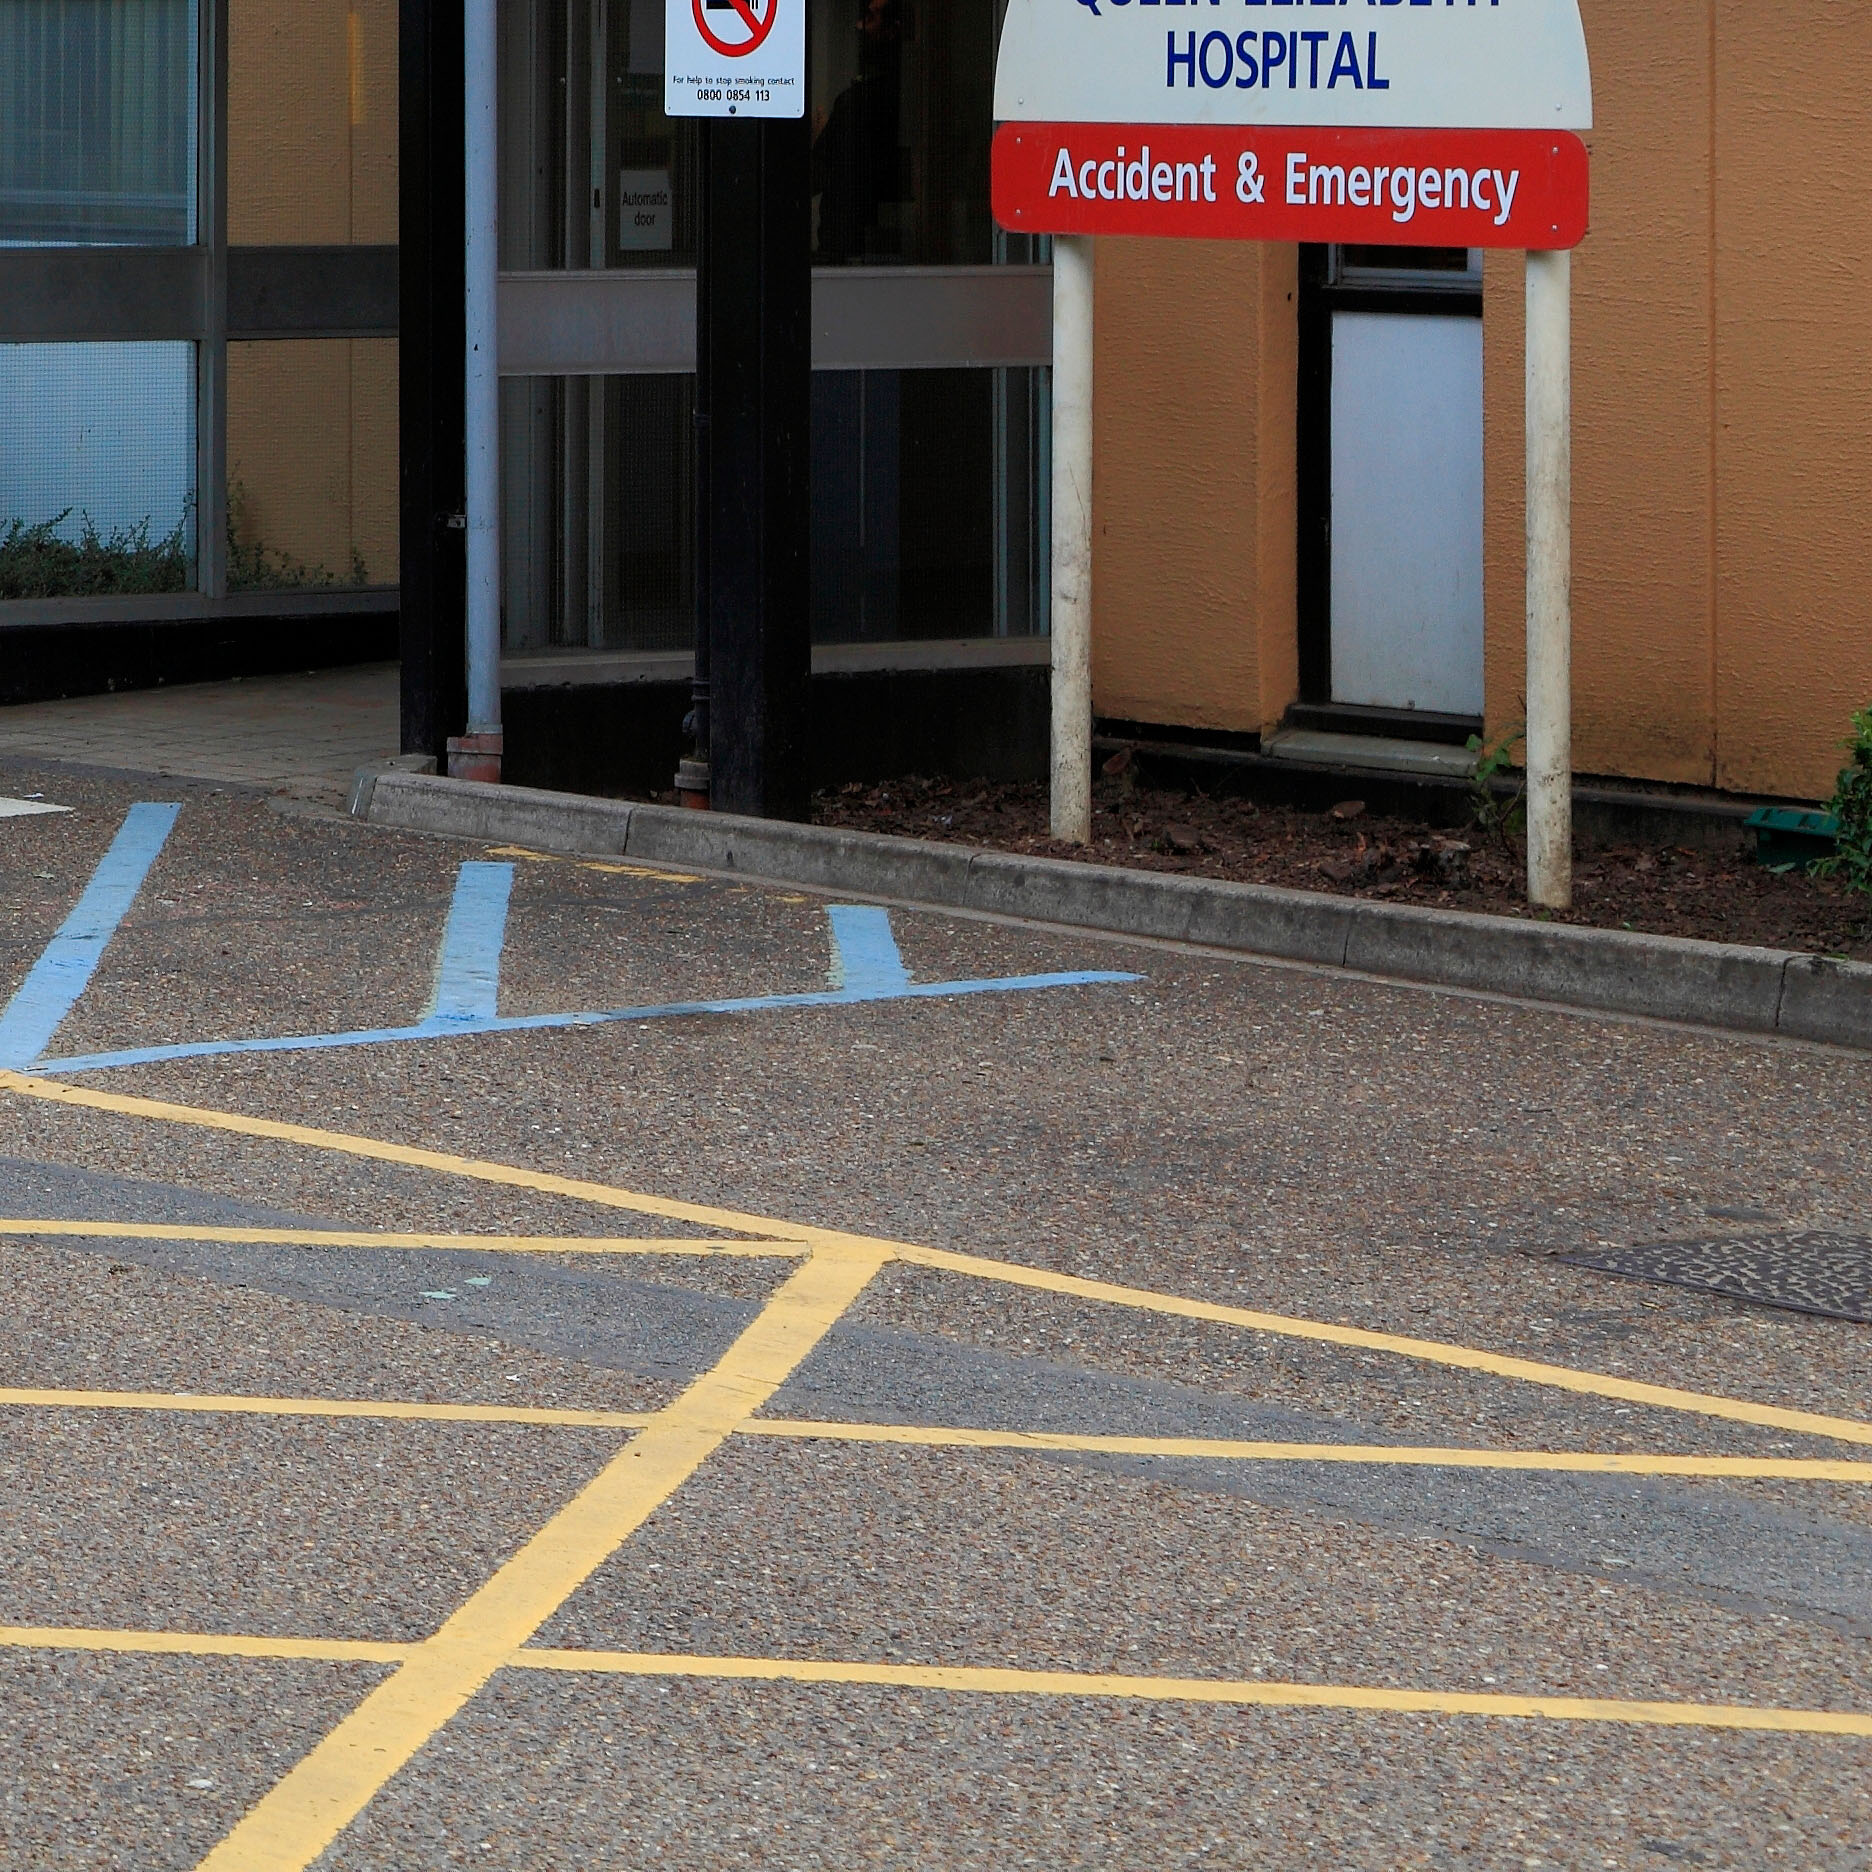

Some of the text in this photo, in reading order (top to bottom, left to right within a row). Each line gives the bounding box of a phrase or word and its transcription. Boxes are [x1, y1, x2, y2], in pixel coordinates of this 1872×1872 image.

[1166, 30, 1390, 90] HOSPITAL
[673, 76, 684, 84] For
[687, 75, 702, 85] help
[716, 76, 732, 85] stop
[735, 76, 764, 87] smoking
[767, 77, 795, 85] contact
[697, 89, 770, 101] 0800 0854 113
[1048, 147, 1520, 226] Accident & Emergency
[622, 190, 668, 206] Automatic
[634, 212, 656, 226] door
